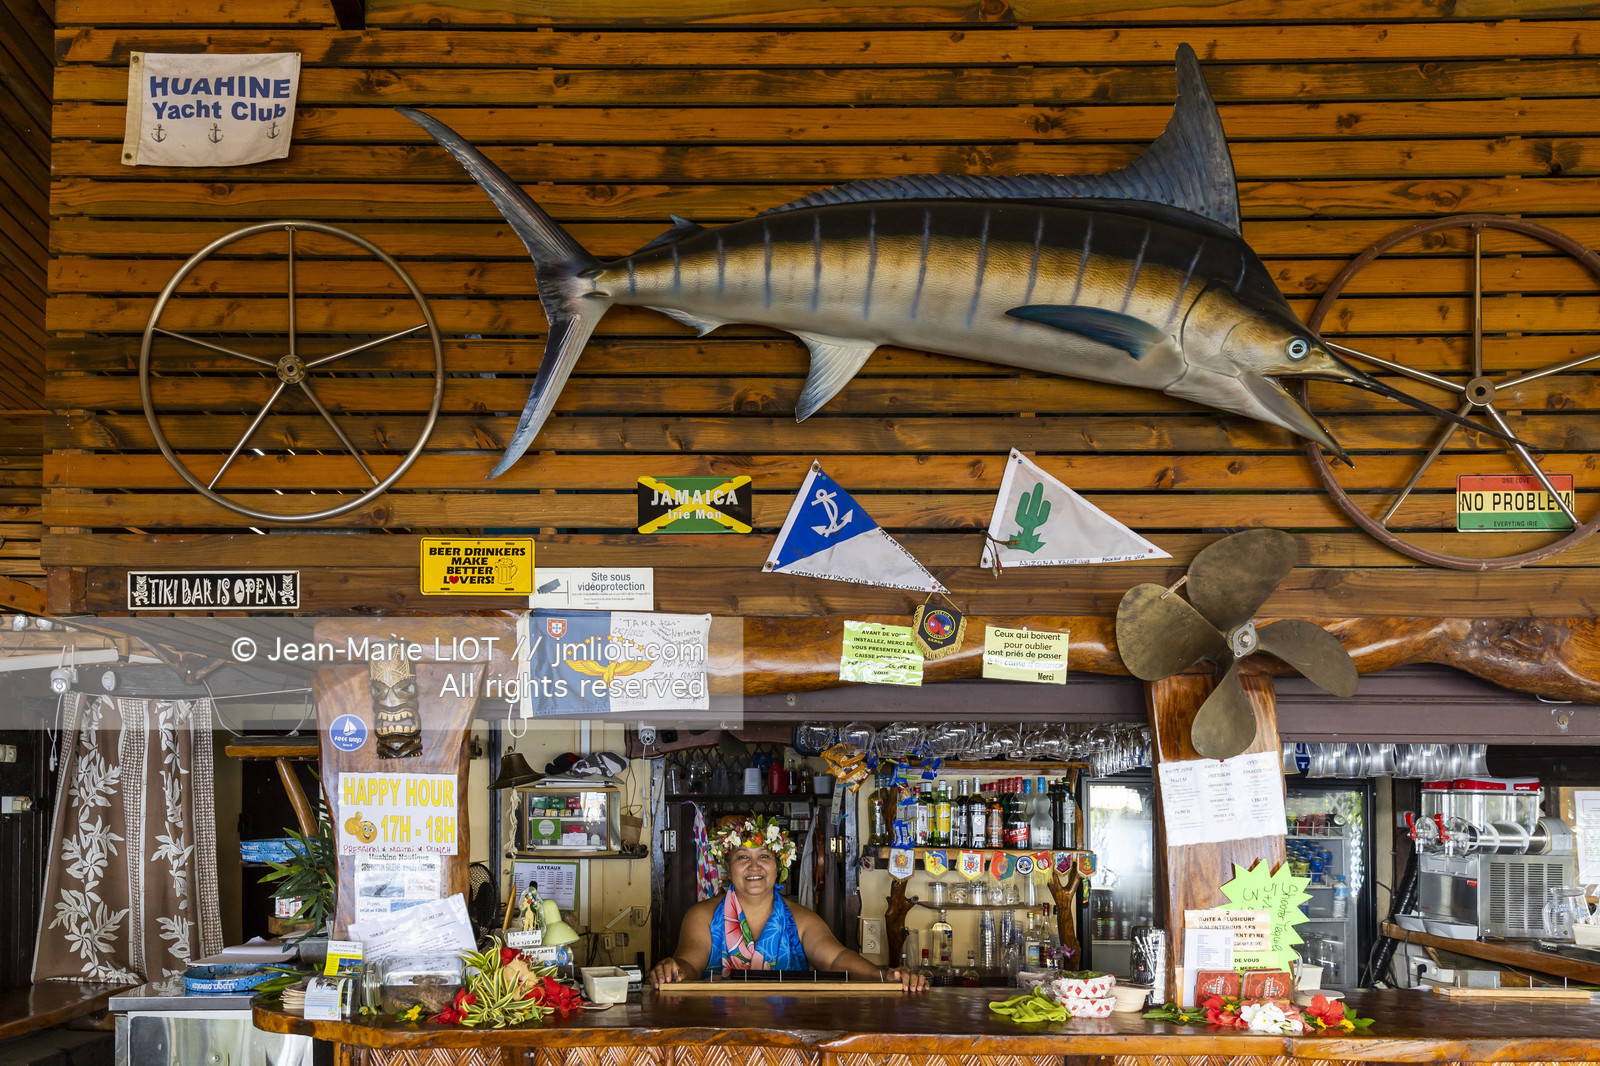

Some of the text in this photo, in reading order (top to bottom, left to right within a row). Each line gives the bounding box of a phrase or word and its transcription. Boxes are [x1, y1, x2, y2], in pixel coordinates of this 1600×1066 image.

[150, 75, 291, 99] HUAHINE
[152, 100, 287, 122] Yacht Club
[651, 489, 738, 506] JAMAICA
[1461, 492, 1570, 511] NO PROBLEM
[667, 509, 722, 519] Irie Mon
[429, 547, 526, 556] BEER DRINKERS
[451, 557, 488, 565] MAKE
[1019, 559, 1054, 567] ARIZONA
[446, 566, 493, 575] BETTER
[591, 572, 631, 582] Site sous
[148, 575, 277, 606] TIKI BAR IS OPEN
[577, 581, 645, 592] vidéoprotection
[994, 629, 1014, 638] Ceux
[1030, 632, 1061, 641] boivent
[853, 637, 886, 645] INSTALLEZ,
[1025, 642, 1052, 651] oublier
[1005, 650, 1024, 658] priés
[1037, 672, 1055, 681] Merci
[343, 777, 455, 808] HAPPY HOUR
[380, 814, 411, 843] 17H
[425, 815, 456, 844] 18H
[1278, 882, 1299, 920] Shooter
